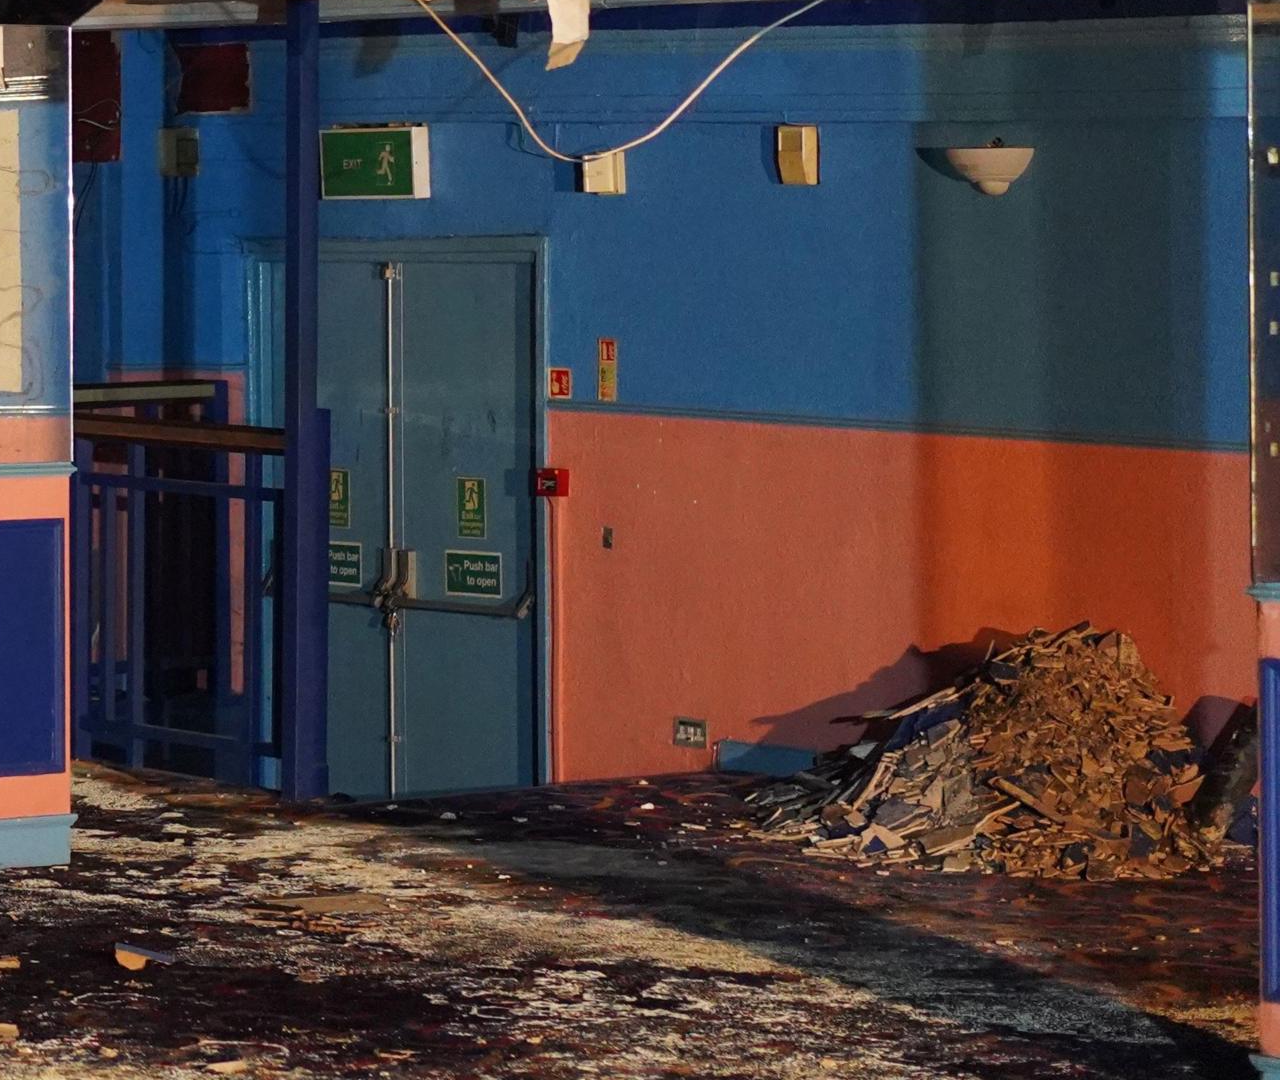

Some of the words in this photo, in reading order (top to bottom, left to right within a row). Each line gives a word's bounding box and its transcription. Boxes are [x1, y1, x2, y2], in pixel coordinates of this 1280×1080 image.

[343, 159, 362, 169] EXIT
[347, 551, 359, 562] bar
[330, 565, 338, 574] to
[339, 567, 357, 577] open
[463, 560, 484, 572] Push
[485, 561, 498, 573] bar
[466, 576, 475, 585] to
[476, 577, 497, 589] open
